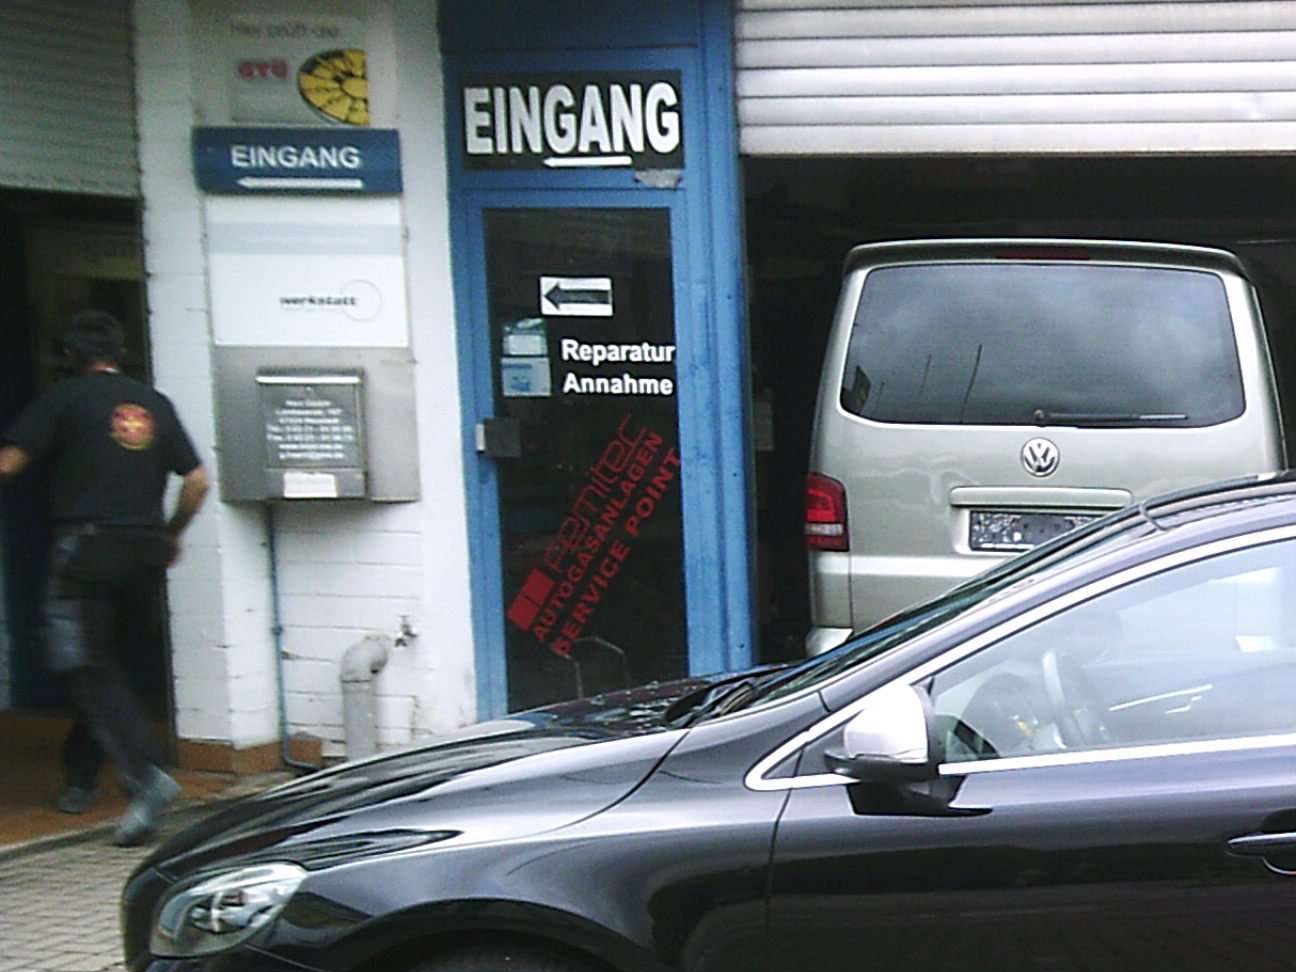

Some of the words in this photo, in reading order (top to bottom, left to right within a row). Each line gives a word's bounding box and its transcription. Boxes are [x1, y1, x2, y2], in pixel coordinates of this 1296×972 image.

[463, 82, 680, 154] EINGANG
[230, 145, 363, 169] EINGANG
[561, 338, 676, 367] Reparatur
[562, 372, 674, 396] Annahme
[624, 446, 682, 537] POINT
[533, 431, 664, 642] AUTOGASANLAGEN
